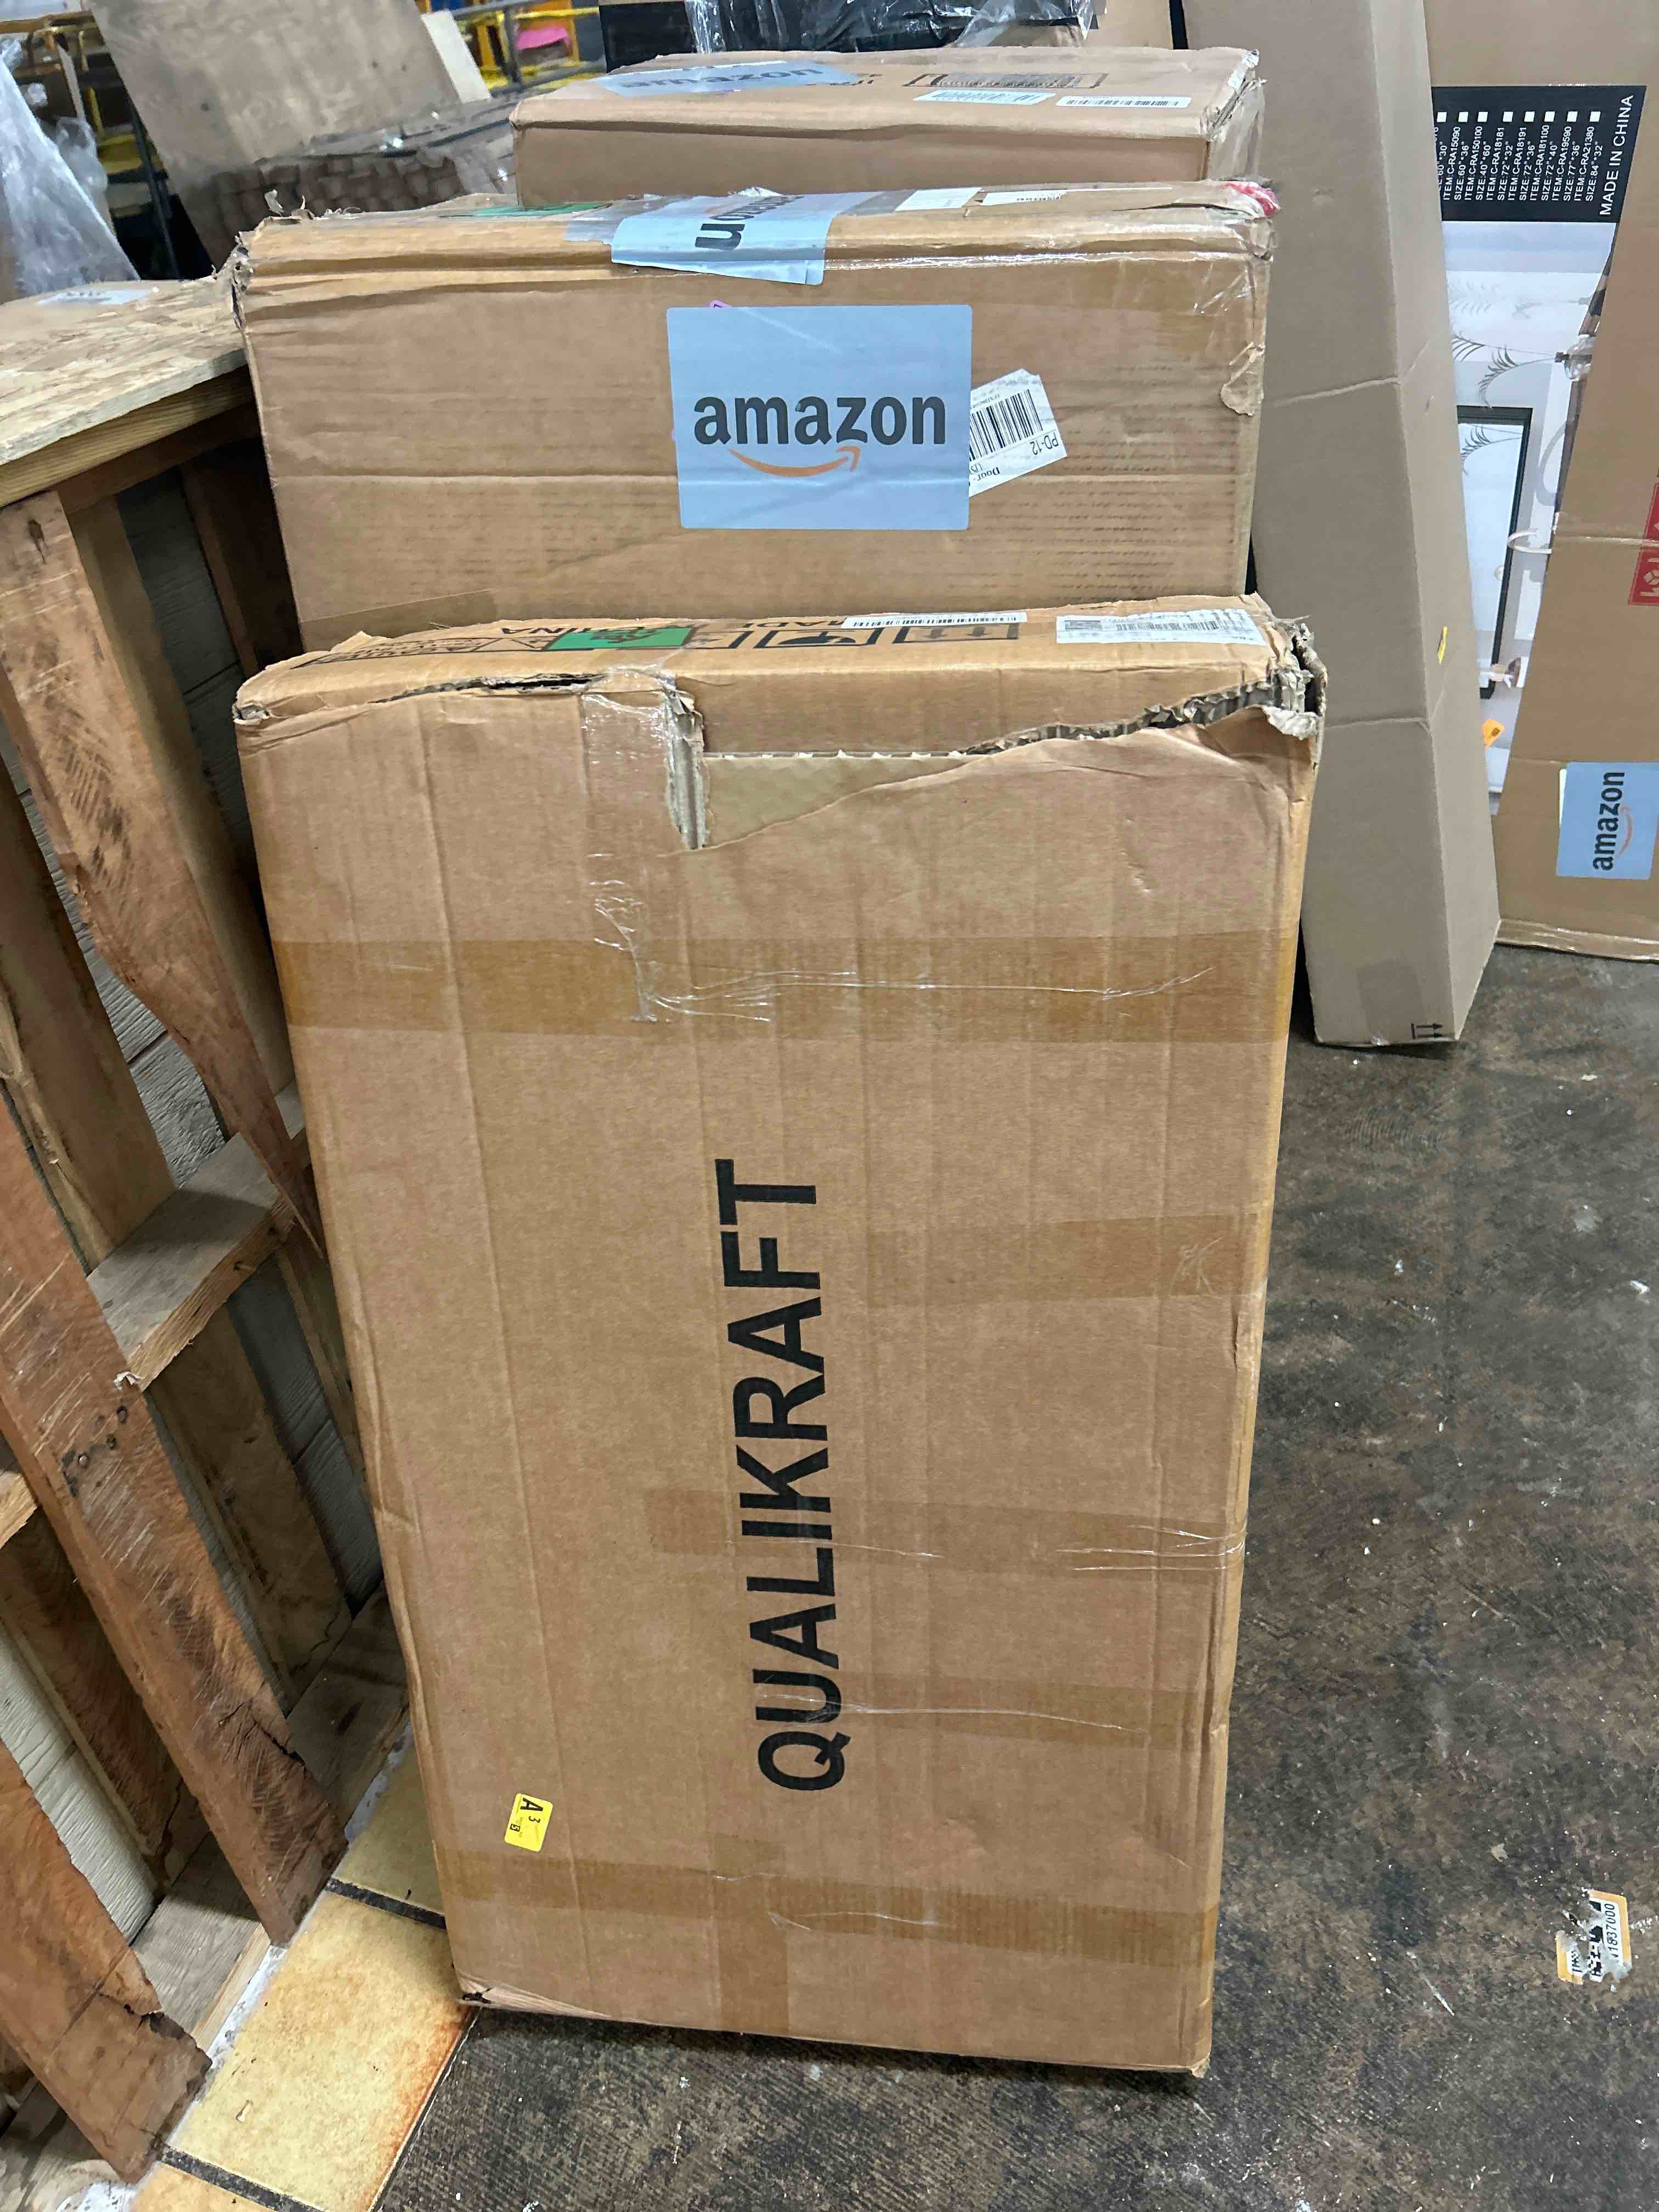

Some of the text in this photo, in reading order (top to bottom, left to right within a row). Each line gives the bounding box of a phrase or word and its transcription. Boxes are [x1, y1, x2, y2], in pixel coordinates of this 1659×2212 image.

[1599, 95, 1634, 216] MADE IN CHINA
[694, 395, 946, 445] amazon
[1029, 432, 1059, 456] PD-12
[1593, 771, 1626, 871] amazon
[715, 1158, 851, 1791] QUALIKRAFT
